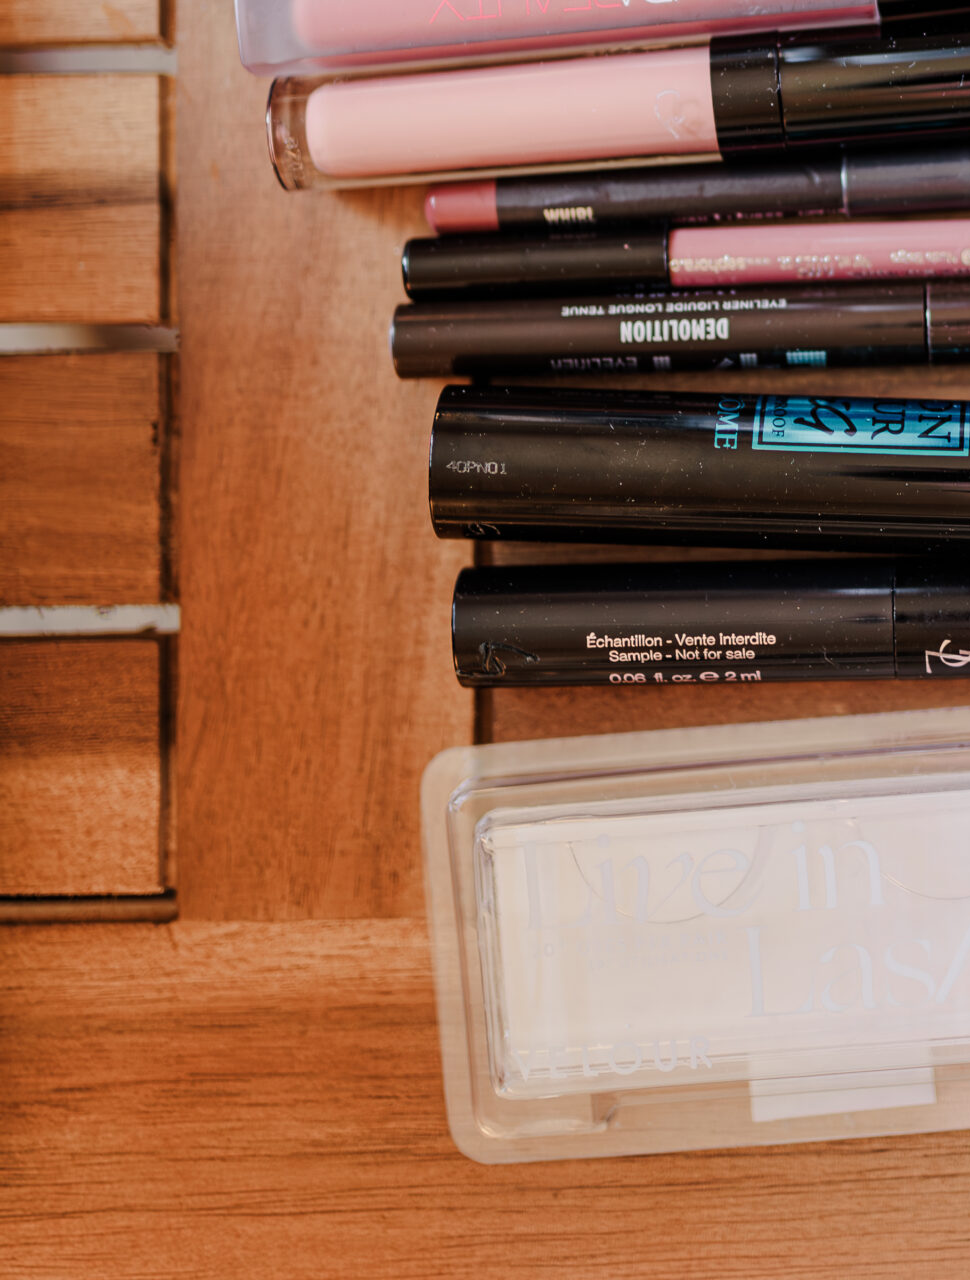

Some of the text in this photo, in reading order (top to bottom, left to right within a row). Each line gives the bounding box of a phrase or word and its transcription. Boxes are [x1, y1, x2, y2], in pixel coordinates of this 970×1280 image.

[561, 298, 788, 317] EYELINER LIQUIDE LONGUE TENUE
[620, 318, 730, 344] DEMOLITION
[586, 631, 663, 649] Échantillon
[674, 633, 716, 648] Vente
[608, 648, 663, 663] Sample
[674, 648, 701, 661] Not
[703, 648, 722, 660] for
[725, 647, 756, 660] sale
[608, 672, 647, 684] 0.06
[671, 673, 697, 683] oz.
[724, 671, 738, 681] 2
[740, 669, 762, 681] ml
[788, 818, 888, 914] in
[509, 1034, 714, 1083] VELOUR
